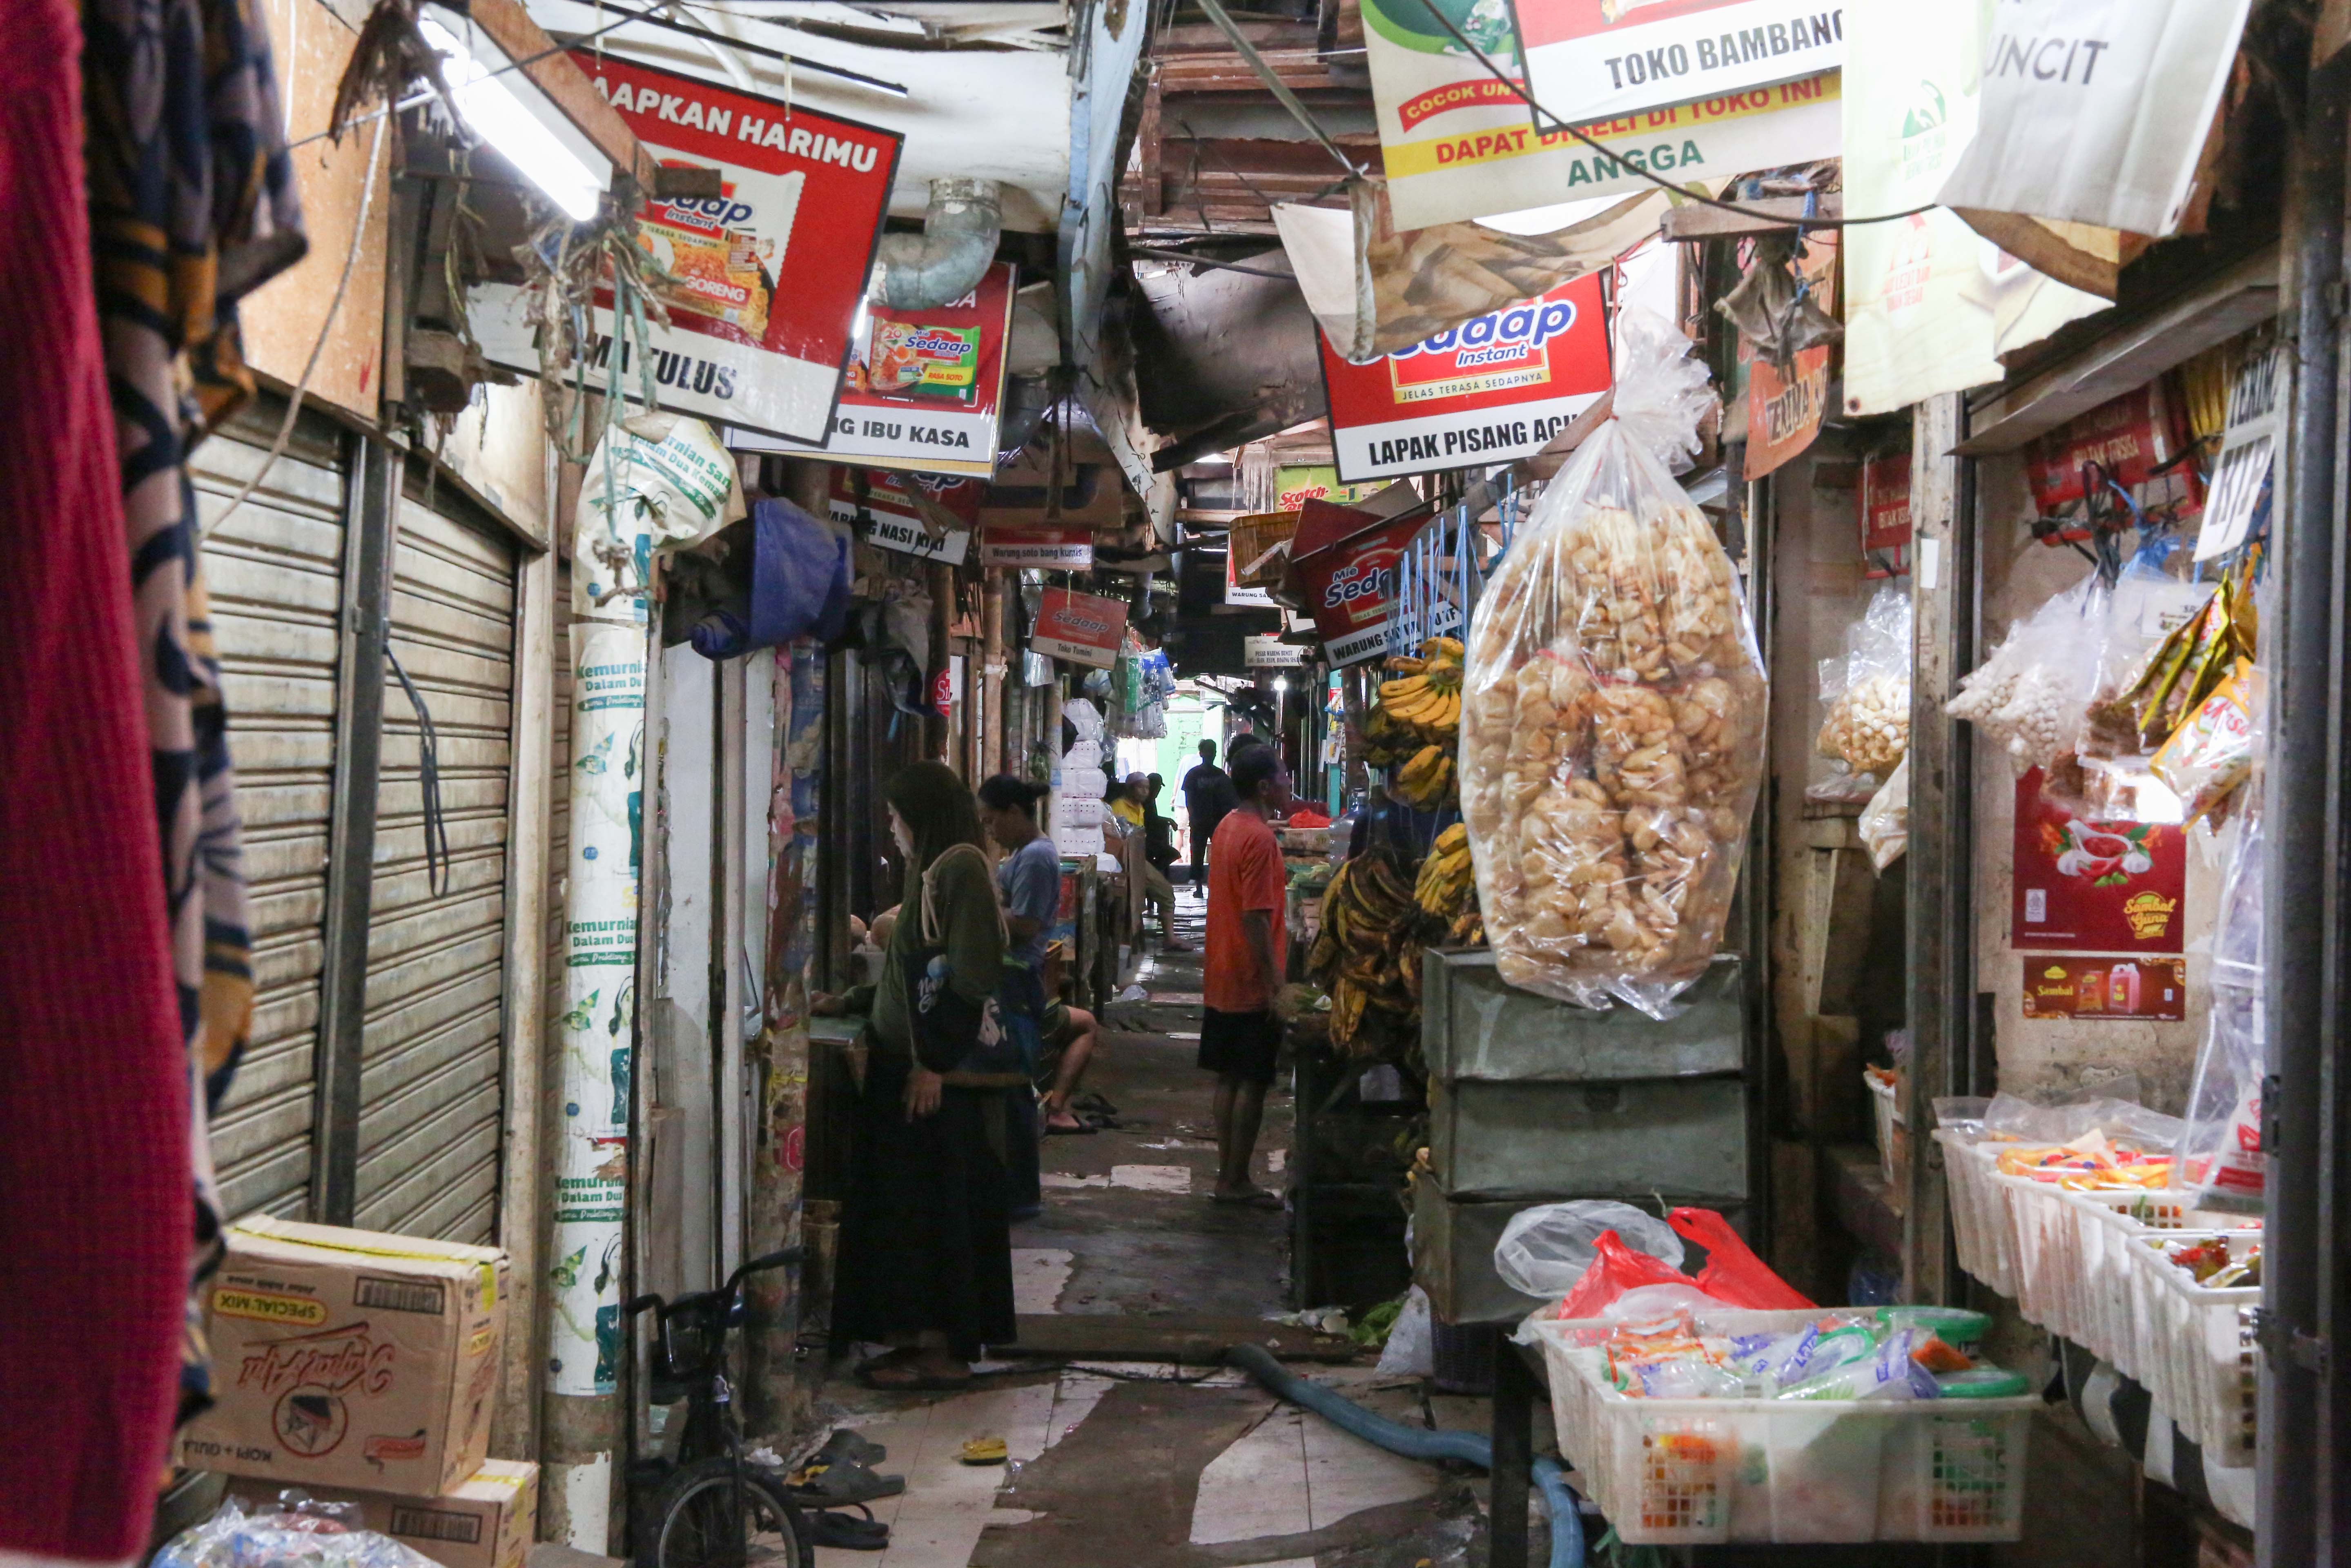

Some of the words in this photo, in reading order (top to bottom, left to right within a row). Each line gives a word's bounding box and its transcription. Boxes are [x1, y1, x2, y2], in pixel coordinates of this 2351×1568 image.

[1604, 43, 1689, 90] TOKO
[1407, 86, 1476, 119] COCOK
[1436, 129, 1528, 164] DAPAT
[1691, 90, 1769, 119] TOKO
[1779, 76, 1823, 103] INI
[738, 114, 878, 173] HARIMU
[1567, 139, 1705, 187] ANGGA
[686, 276, 746, 302] GORENG
[905, 336, 972, 354] Sedaap
[1457, 343, 1529, 367] Instant
[1402, 389, 1434, 400] JELAS
[1440, 382, 1480, 394] TERASA
[1486, 372, 1542, 388] SEDAPNYA
[862, 421, 902, 440] IBU
[909, 426, 970, 448] KASA
[1369, 434, 1440, 466] LAPAK
[1444, 421, 1527, 454] PISANG
[669, 453, 690, 473] Dua
[877, 523, 914, 544] NASI
[992, 548, 1020, 559] Warung
[1023, 548, 1038, 557] soto
[1041, 548, 1058, 559] bang
[1333, 566, 1359, 582] Mie
[1052, 611, 1109, 633] Sedaap
[1058, 644, 1072, 653] Toko
[1333, 633, 1383, 661] WARUNG
[586, 679, 626, 692] Dalam
[573, 935, 614, 947] Dalam
[561, 1192, 602, 1203] Dalam
[219, 1295, 250, 1312] MIX
[254, 1298, 317, 1319] SPECIAL
[235, 1447, 272, 1463] KOPI
